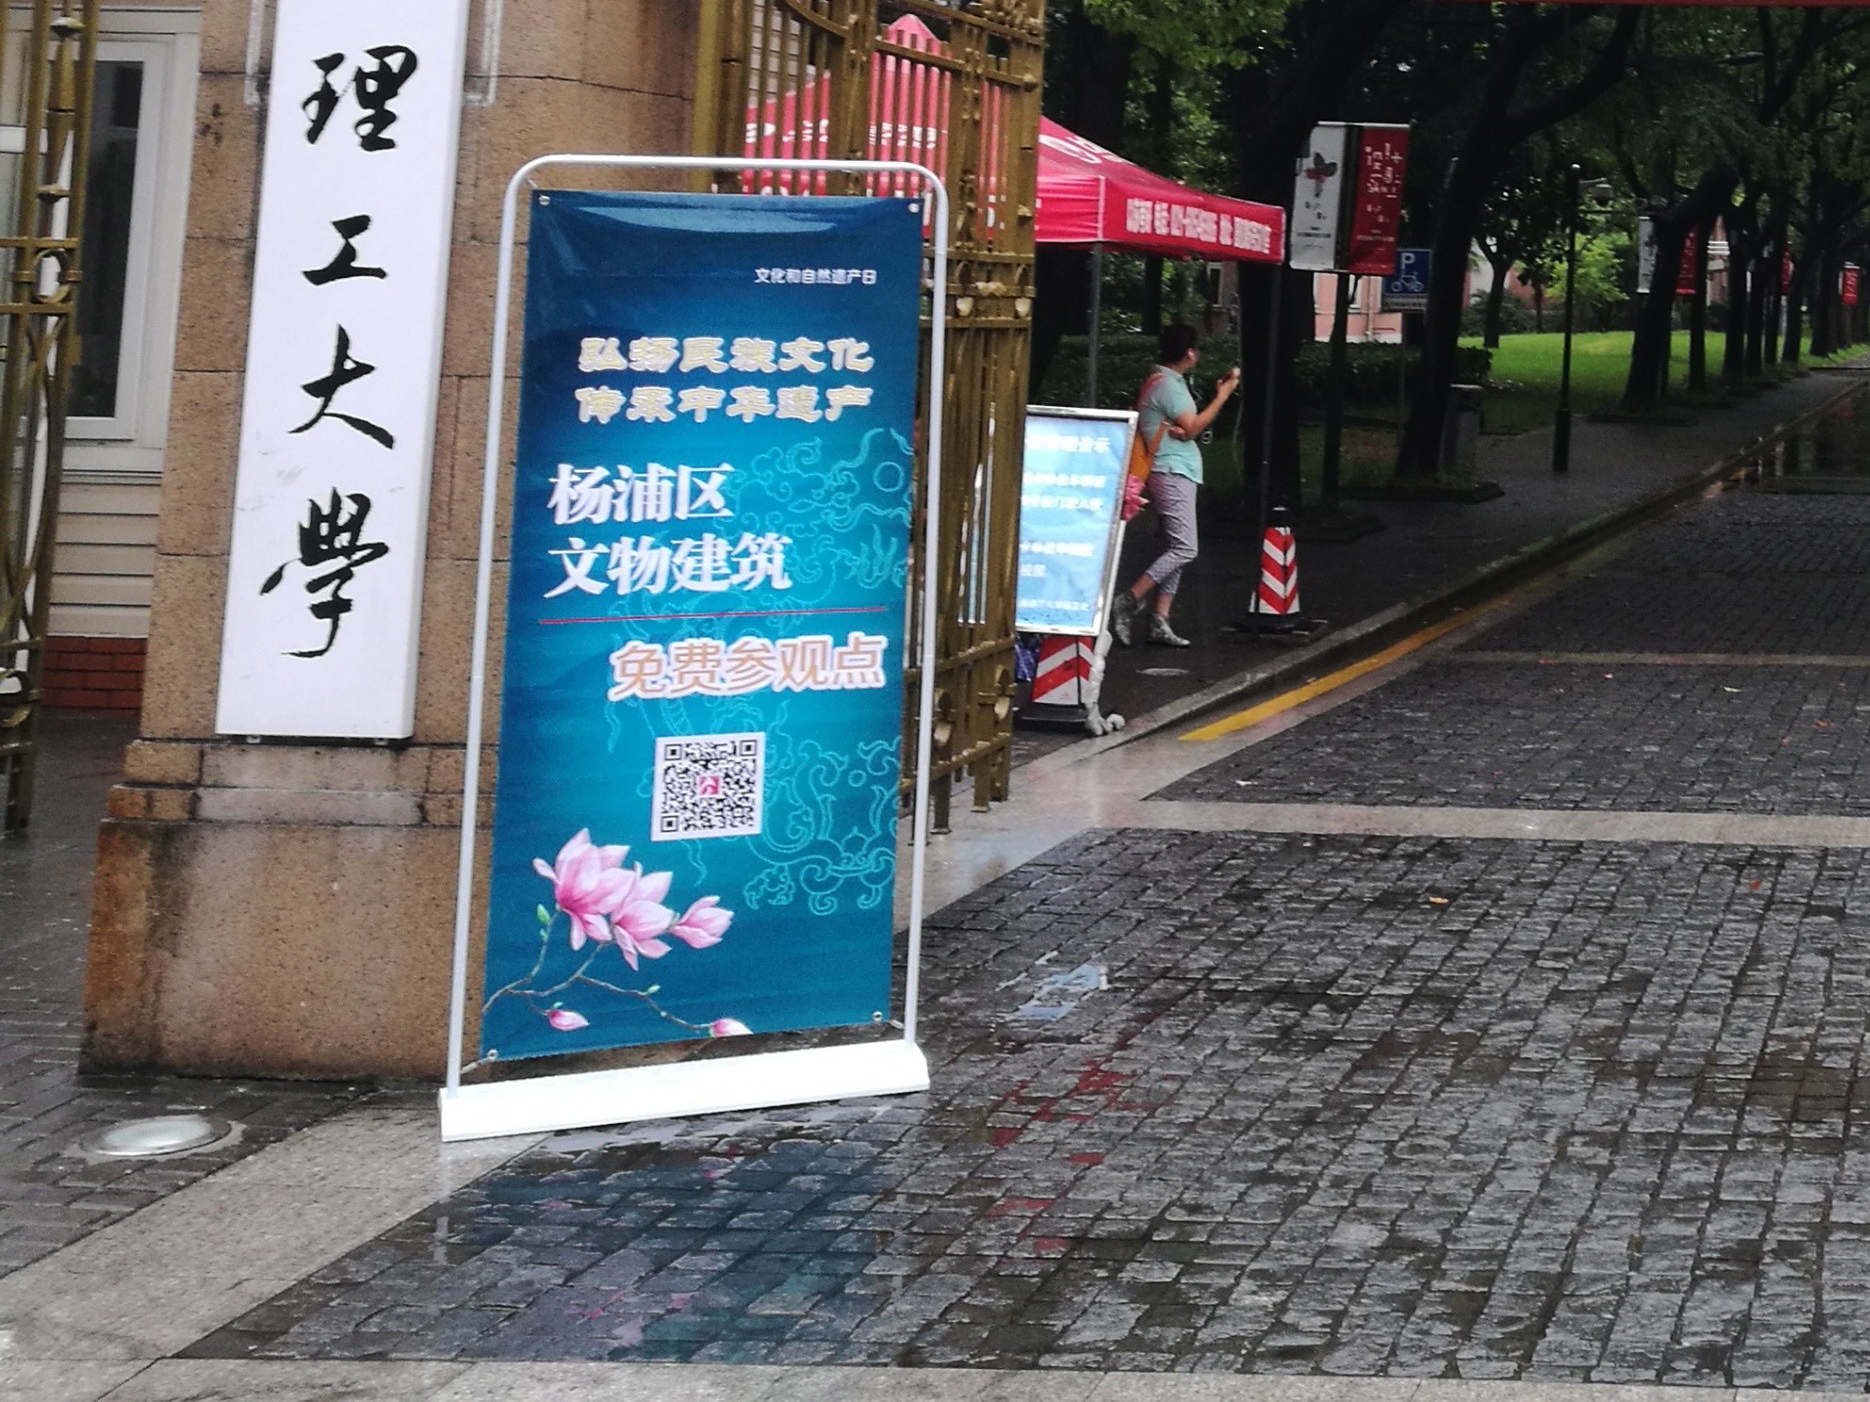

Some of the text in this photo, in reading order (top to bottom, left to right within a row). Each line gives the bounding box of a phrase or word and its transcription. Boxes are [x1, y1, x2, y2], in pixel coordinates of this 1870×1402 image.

[754, 267, 877, 285] 文化和自然遗产日
[578, 336, 875, 374] 弘扬民族文化
[574, 384, 874, 424] 传承中华遗产
[547, 462, 735, 525] 杨浦区
[544, 532, 793, 598] 文物建筑
[607, 630, 888, 702] 免费参观点
